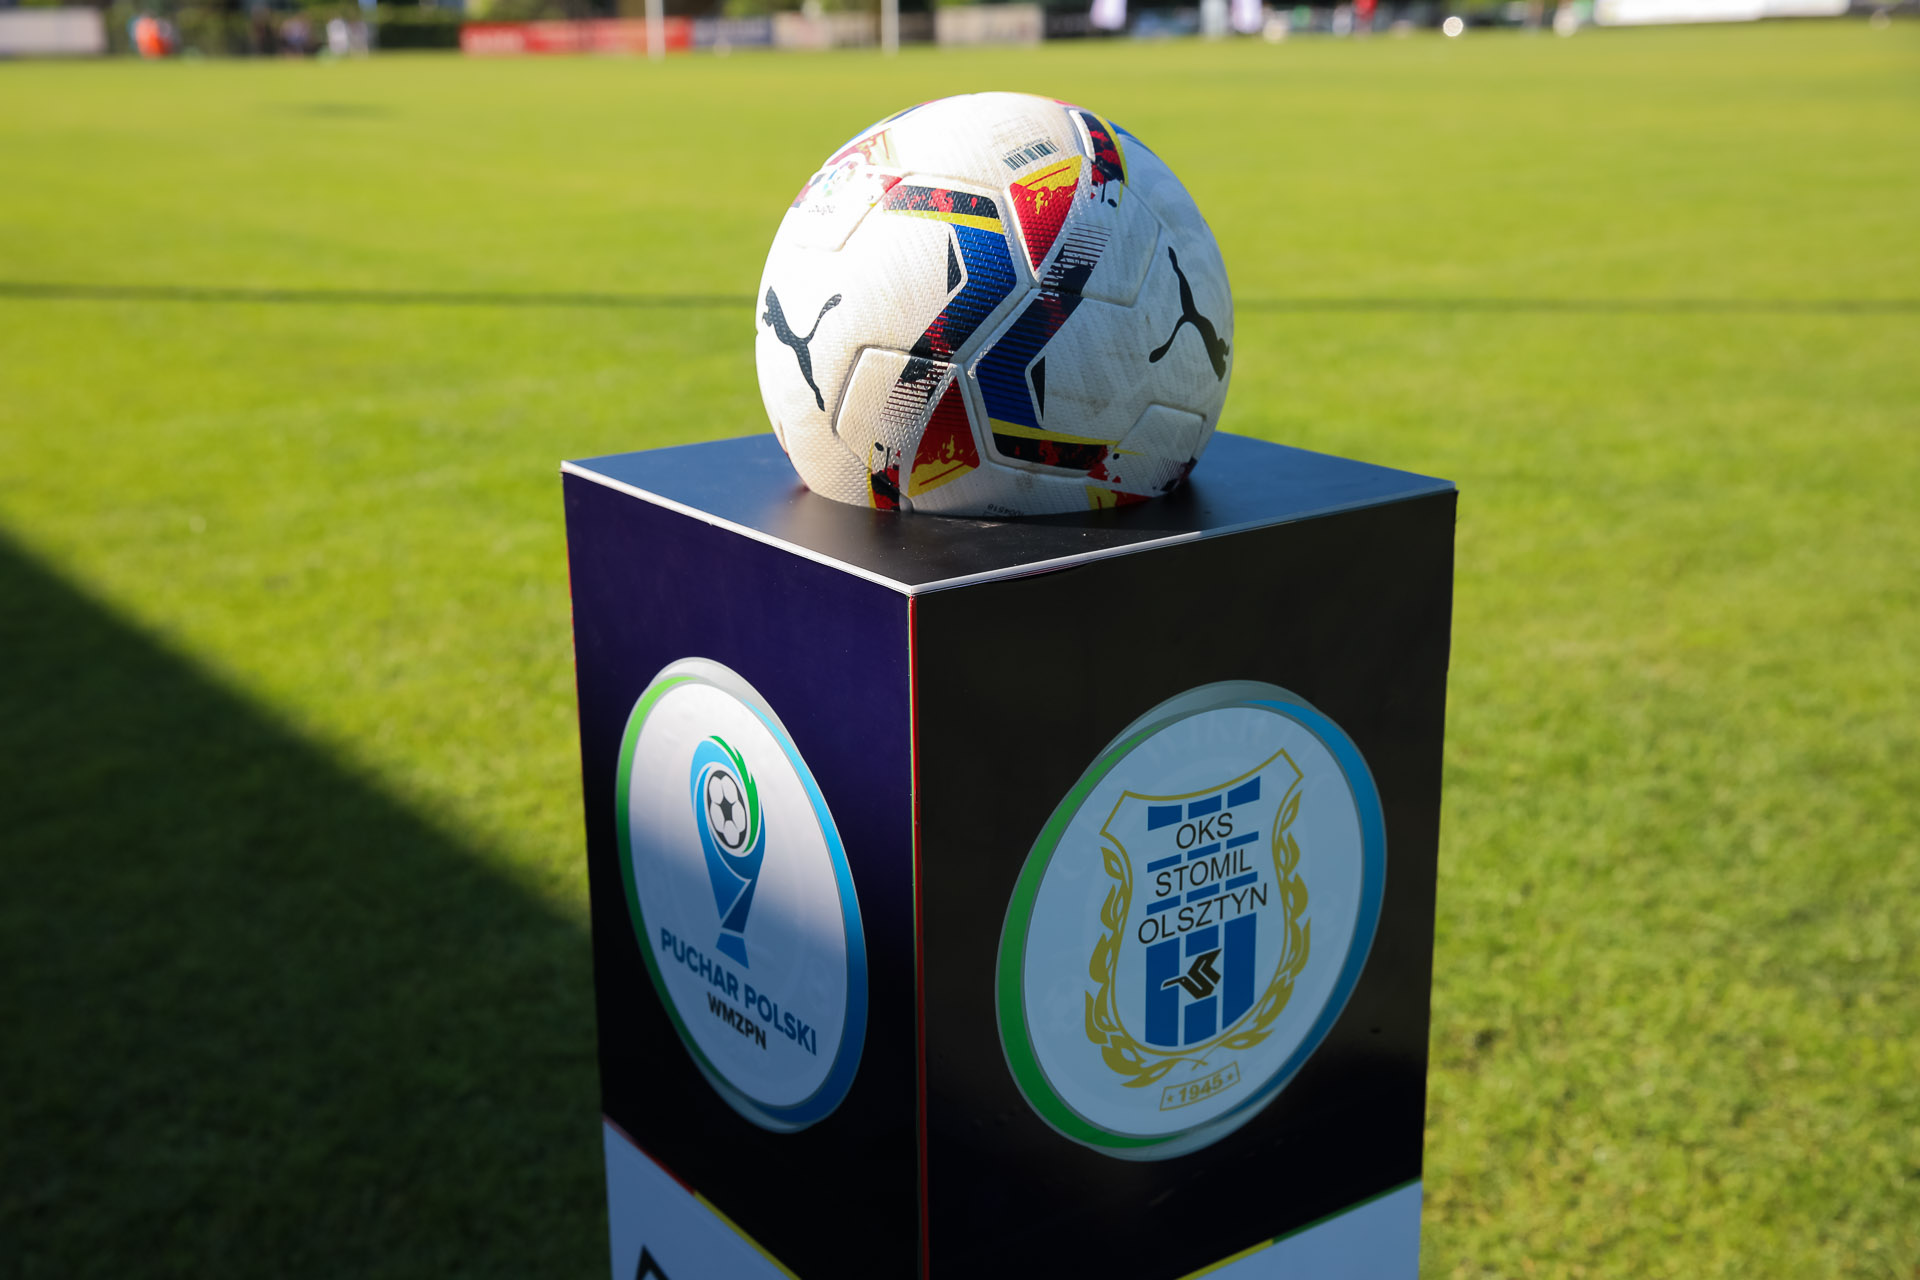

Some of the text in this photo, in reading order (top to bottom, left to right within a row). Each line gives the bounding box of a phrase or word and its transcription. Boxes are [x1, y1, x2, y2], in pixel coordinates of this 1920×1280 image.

[1176, 812, 1233, 849] OKS
[1155, 849, 1252, 897] STOMIL
[1138, 883, 1267, 944] OLSZTYN
[661, 927, 817, 1056] PUCHAR POLSKI
[707, 992, 767, 1050] WMZPN
[1178, 1075, 1223, 1104] 1945
